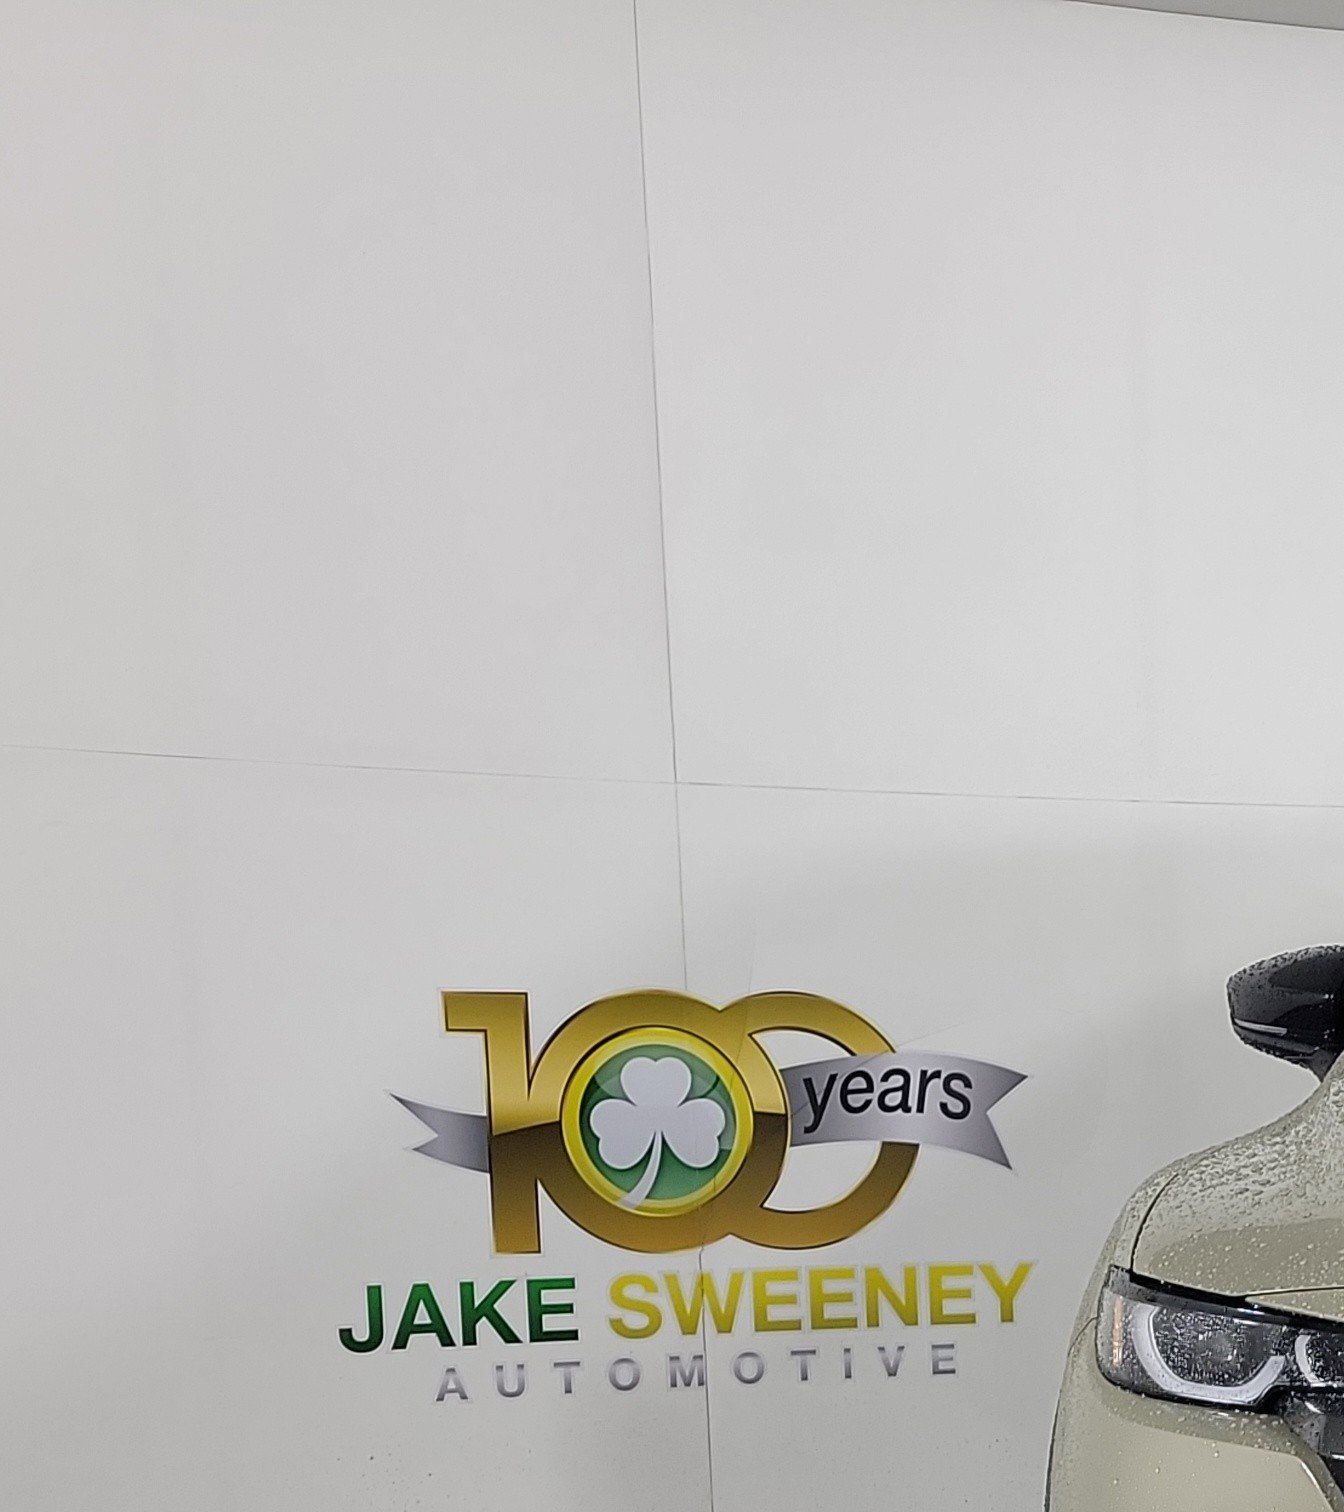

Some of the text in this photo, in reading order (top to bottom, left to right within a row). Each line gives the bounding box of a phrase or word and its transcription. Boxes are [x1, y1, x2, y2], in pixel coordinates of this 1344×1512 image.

[440, 989, 973, 1255] 100 years
[338, 1260, 1034, 1354] JAKE SWEENEY
[435, 1343, 957, 1402] AUTOMOTIVE
